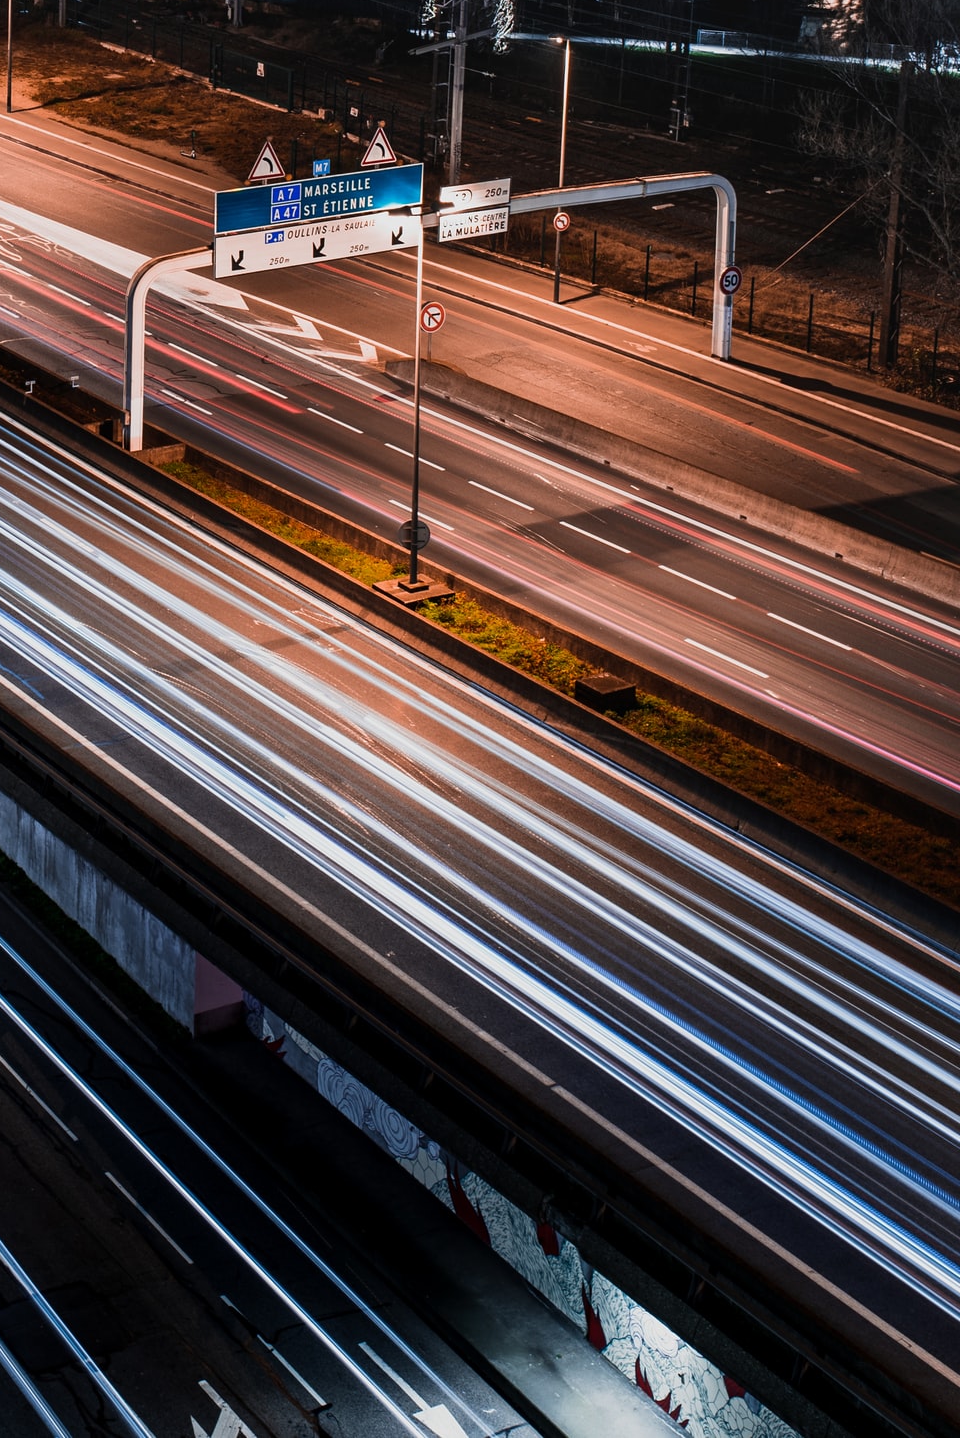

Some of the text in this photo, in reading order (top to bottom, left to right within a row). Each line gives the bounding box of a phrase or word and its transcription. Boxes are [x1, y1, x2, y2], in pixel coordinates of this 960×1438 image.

[315, 162, 329, 173] M7
[277, 188, 294, 201] A 7
[304, 178, 371, 198] MARSEILLE
[304, 195, 374, 217] ST ÉTIENNE
[273, 206, 298, 221] A 47
[345, 219, 376, 231] SAULAIE
[442, 220, 506, 239] LA MULATIÈRE
[724, 274, 738, 288] 50
